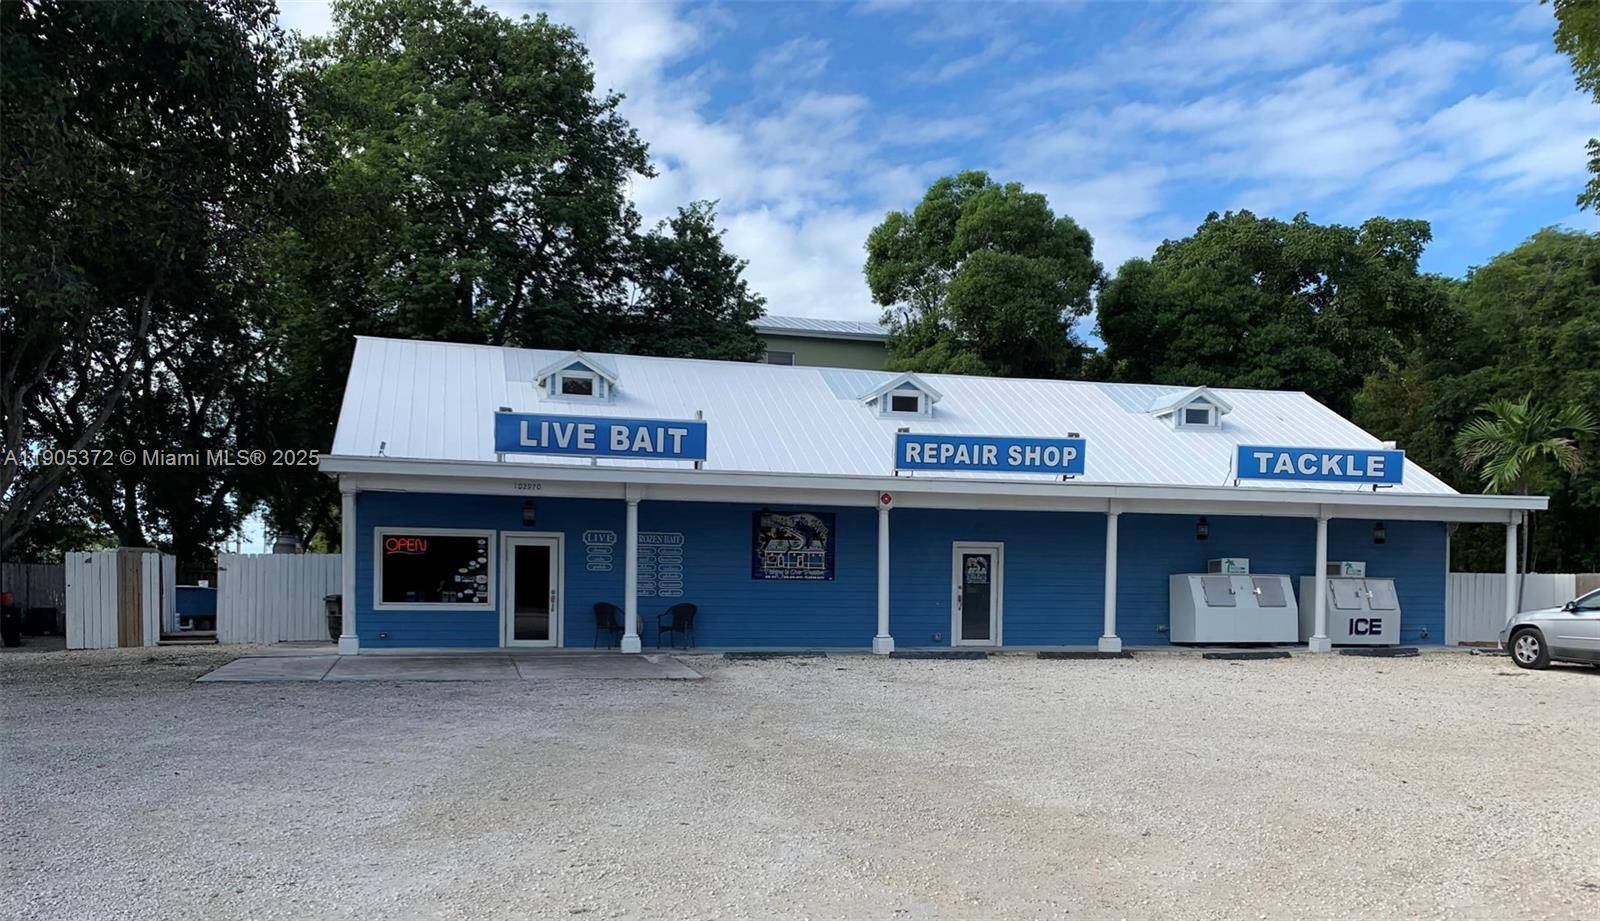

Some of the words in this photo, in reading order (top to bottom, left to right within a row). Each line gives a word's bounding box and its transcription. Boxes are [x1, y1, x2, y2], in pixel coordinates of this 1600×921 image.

[519, 420, 596, 449] LIVE
[610, 425, 688, 453] BAIT
[905, 442, 998, 465] REPAIR
[1007, 445, 1077, 467] SHOP
[1253, 452, 1386, 477] TACKLE
[385, 537, 428, 552] OPEN
[587, 533, 614, 542] LIVE
[638, 534, 663, 543] ROZEN
[1349, 618, 1382, 636] ICE
